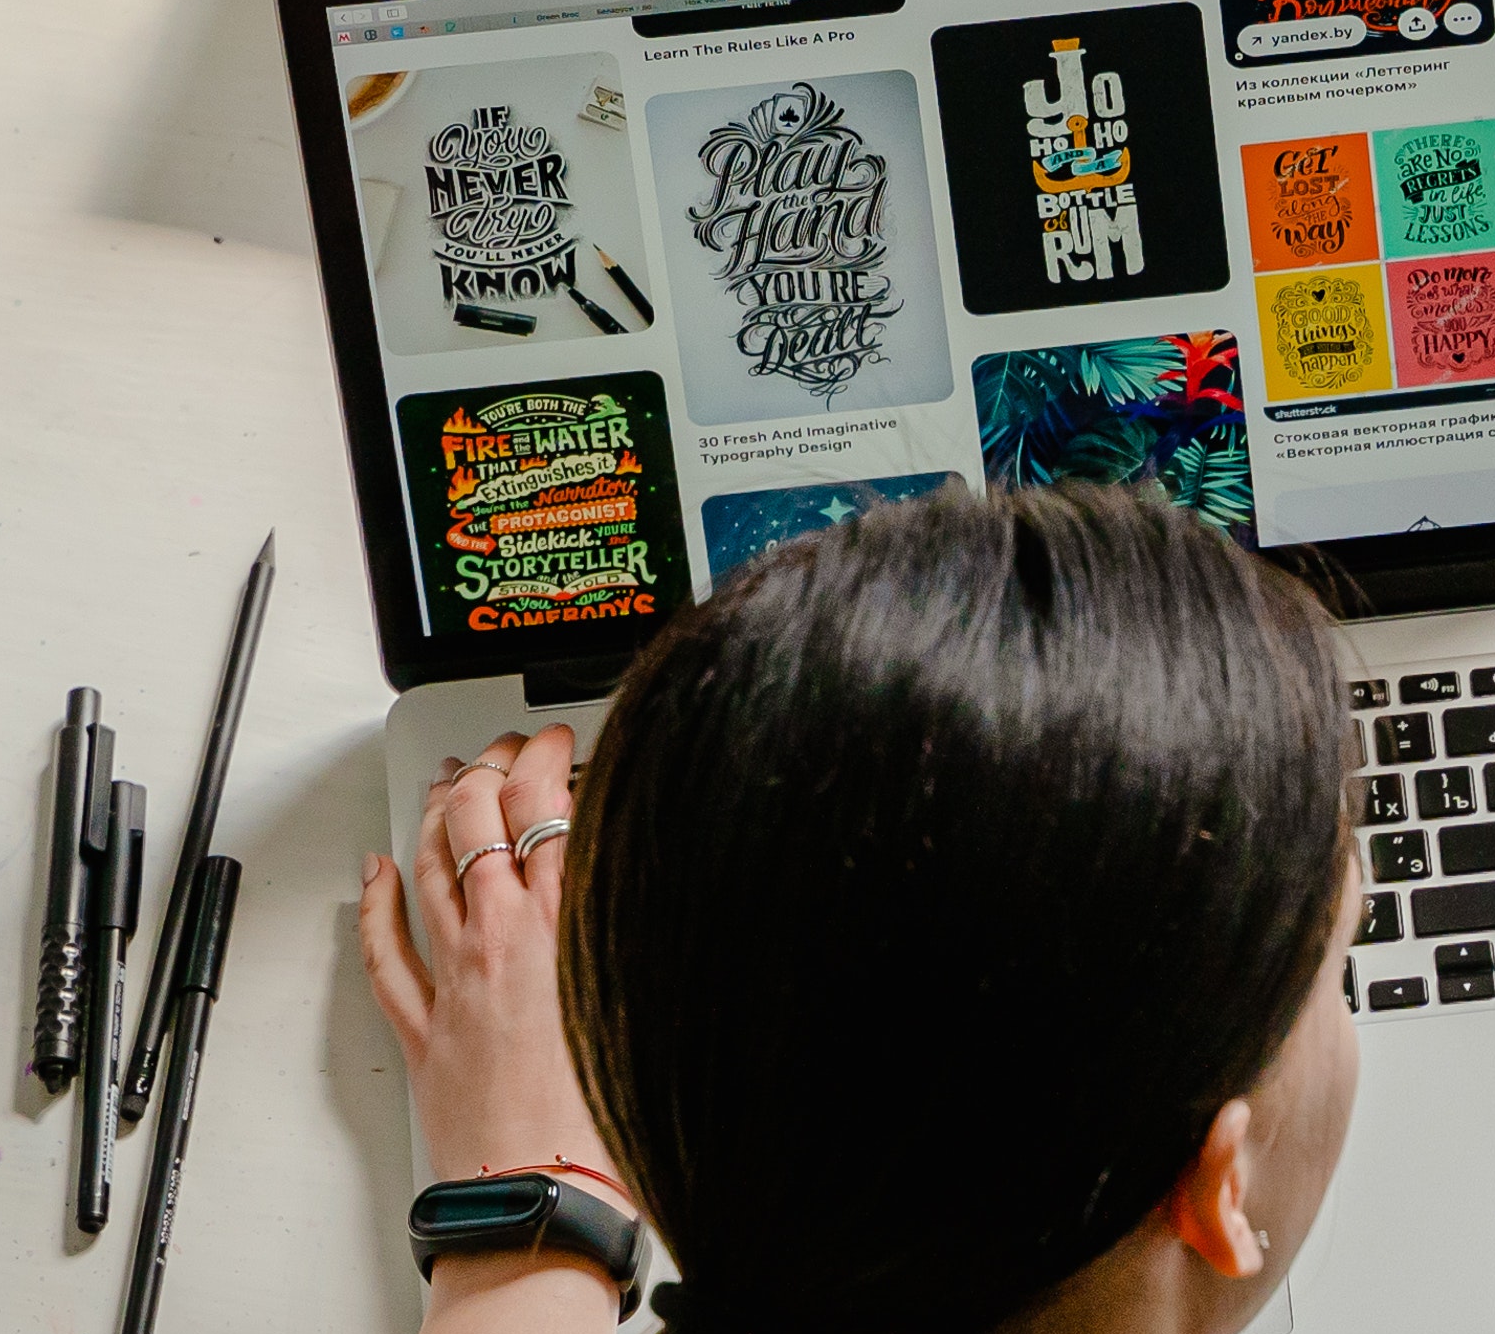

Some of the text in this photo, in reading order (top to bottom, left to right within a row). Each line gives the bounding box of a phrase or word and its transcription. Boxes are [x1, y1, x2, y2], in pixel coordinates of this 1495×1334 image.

[644, 30, 855, 62] Learn The Rules Like A Pro
[1272, 27, 1353, 48] yandex.by
[1236, 60, 1451, 93] Из коллекции «Леттеринг
[1237, 80, 1418, 109] красивым почерком»
[475, 105, 509, 129] IF
[1030, 120, 1128, 157] HO HO
[1406, 134, 1466, 154] THERE
[1052, 149, 1107, 170] AND A
[424, 153, 570, 217] NEVER
[691, 138, 886, 219] Play
[1278, 175, 1340, 198] LOST
[1406, 166, 1477, 193] REGRETS
[782, 192, 808, 210] the
[1036, 183, 1136, 218] BOTTLE
[1277, 194, 1341, 218] along
[1429, 188, 1447, 203] in
[1420, 203, 1466, 224] JUST
[707, 177, 887, 279] Hand
[1404, 214, 1490, 244] LESSONS
[444, 232, 565, 263] YOU'LL NEVER
[1042, 204, 1144, 283] RUM
[440, 241, 578, 302] KNOW
[1443, 267, 1493, 284] more
[1291, 305, 1352, 328] GOOD
[736, 299, 903, 373] Dealt
[1291, 324, 1357, 345] things
[1422, 327, 1490, 354] HAPPY
[1299, 353, 1359, 375] happen
[481, 398, 587, 425] YOU'RE BOTH THE
[441, 434, 514, 470] FIRE
[534, 416, 634, 454] WATER
[699, 418, 897, 449] 30 Fresh And Imaginative
[1274, 427, 1349, 445] Стоковая
[1353, 419, 1436, 437] векторная
[1276, 441, 1373, 460] «Векторная
[1375, 430, 1485, 451] иллюстрация
[700, 439, 852, 466] Typography Design
[476, 459, 518, 481] THAT
[480, 460, 594, 502] Extinguishes
[468, 502, 628, 535] THE PROTAGONIST
[456, 540, 657, 600] STORYTELLER
[561, 571, 581, 584] the
[498, 583, 550, 596] STORY
[1441, 685, 1455, 694] F12
